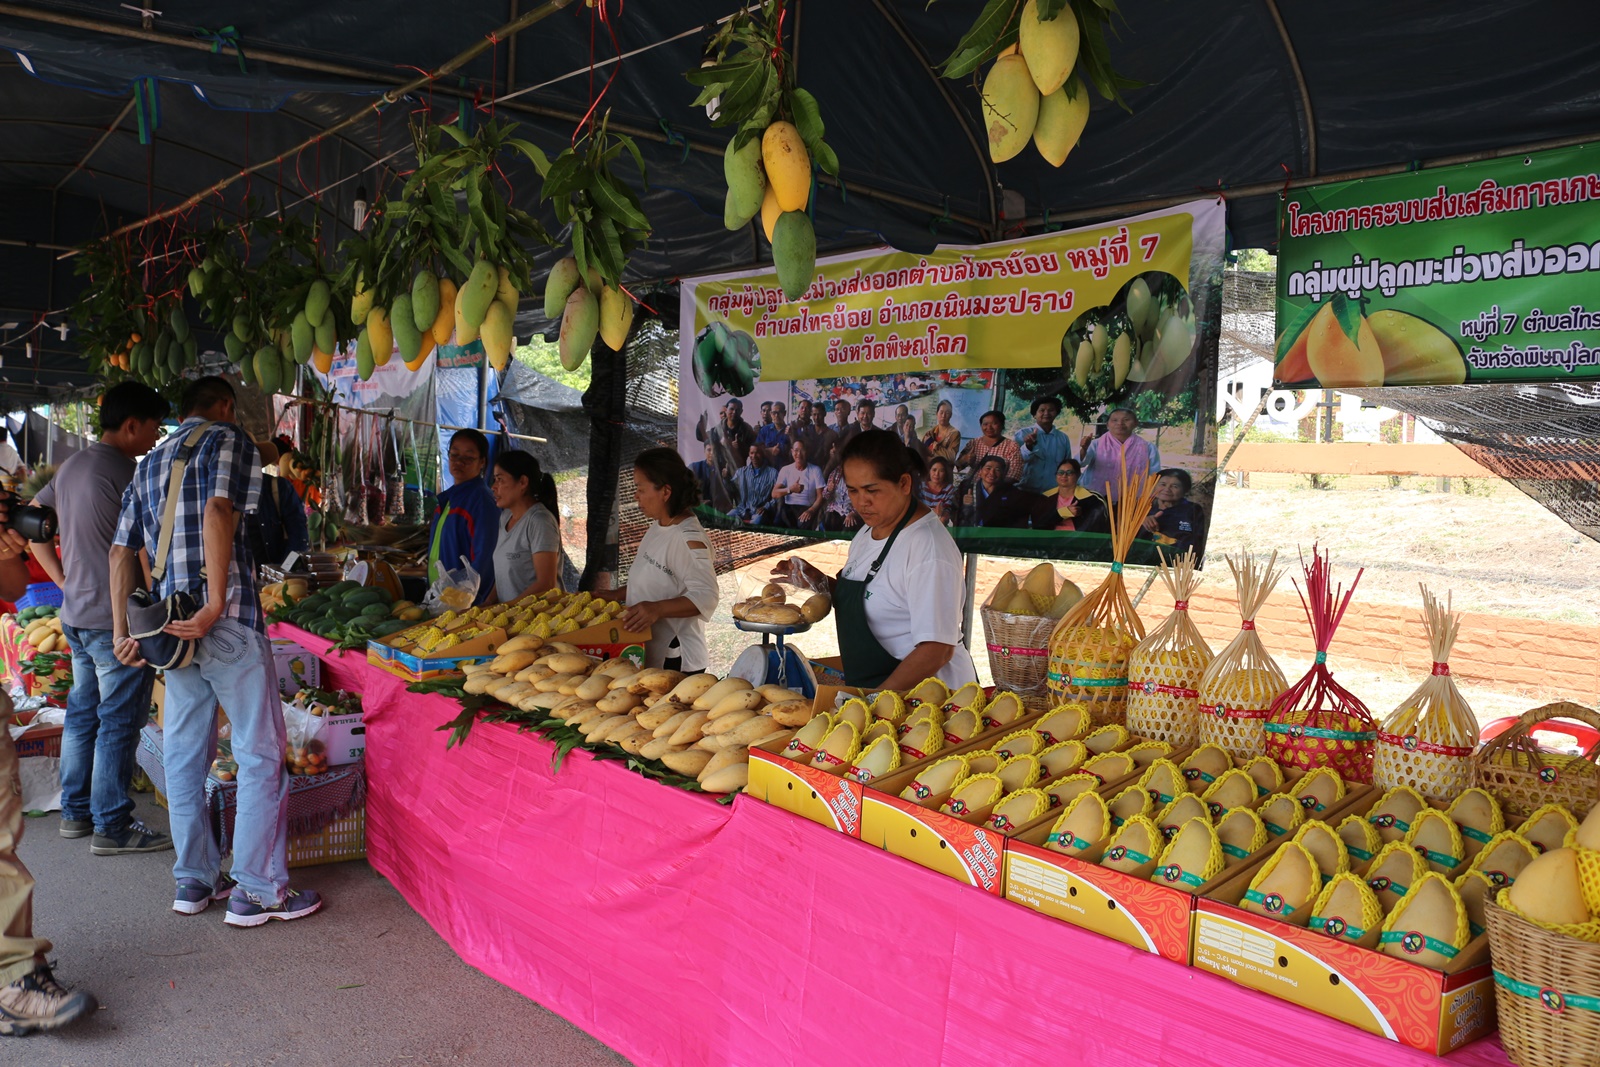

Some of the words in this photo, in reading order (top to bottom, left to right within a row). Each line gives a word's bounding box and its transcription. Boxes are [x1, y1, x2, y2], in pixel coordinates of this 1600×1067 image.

[1066, 227, 1129, 279] หมู่ที่
[1140, 234, 1159, 261] 7
[755, 305, 873, 338] ตำบลไทรย้อย
[879, 288, 1075, 326] อำเภอเนินมะปราง
[1461, 305, 1499, 341] หมู่ที่
[1501, 313, 1518, 334] 7
[827, 324, 968, 366] จังหวัดพิษณุโลก
[839, 779, 858, 807] Mango
[831, 798, 856, 835] Premium
[837, 793, 858, 823] Quality
[973, 829, 998, 860] Mango
[963, 849, 993, 891] Premium
[971, 844, 997, 878] Quality
[1009, 890, 1027, 902] Mango
[1027, 896, 1040, 907] Ripe
[1059, 900, 1070, 909] keep
[1070, 904, 1086, 914] Please
[1197, 955, 1220, 970] Mango
[1221, 964, 1237, 977] Ripe
[1231, 958, 1245, 967] room
[1245, 963, 1257, 971] cool
[1263, 969, 1278, 980] keep
[1278, 975, 1298, 987] Please
